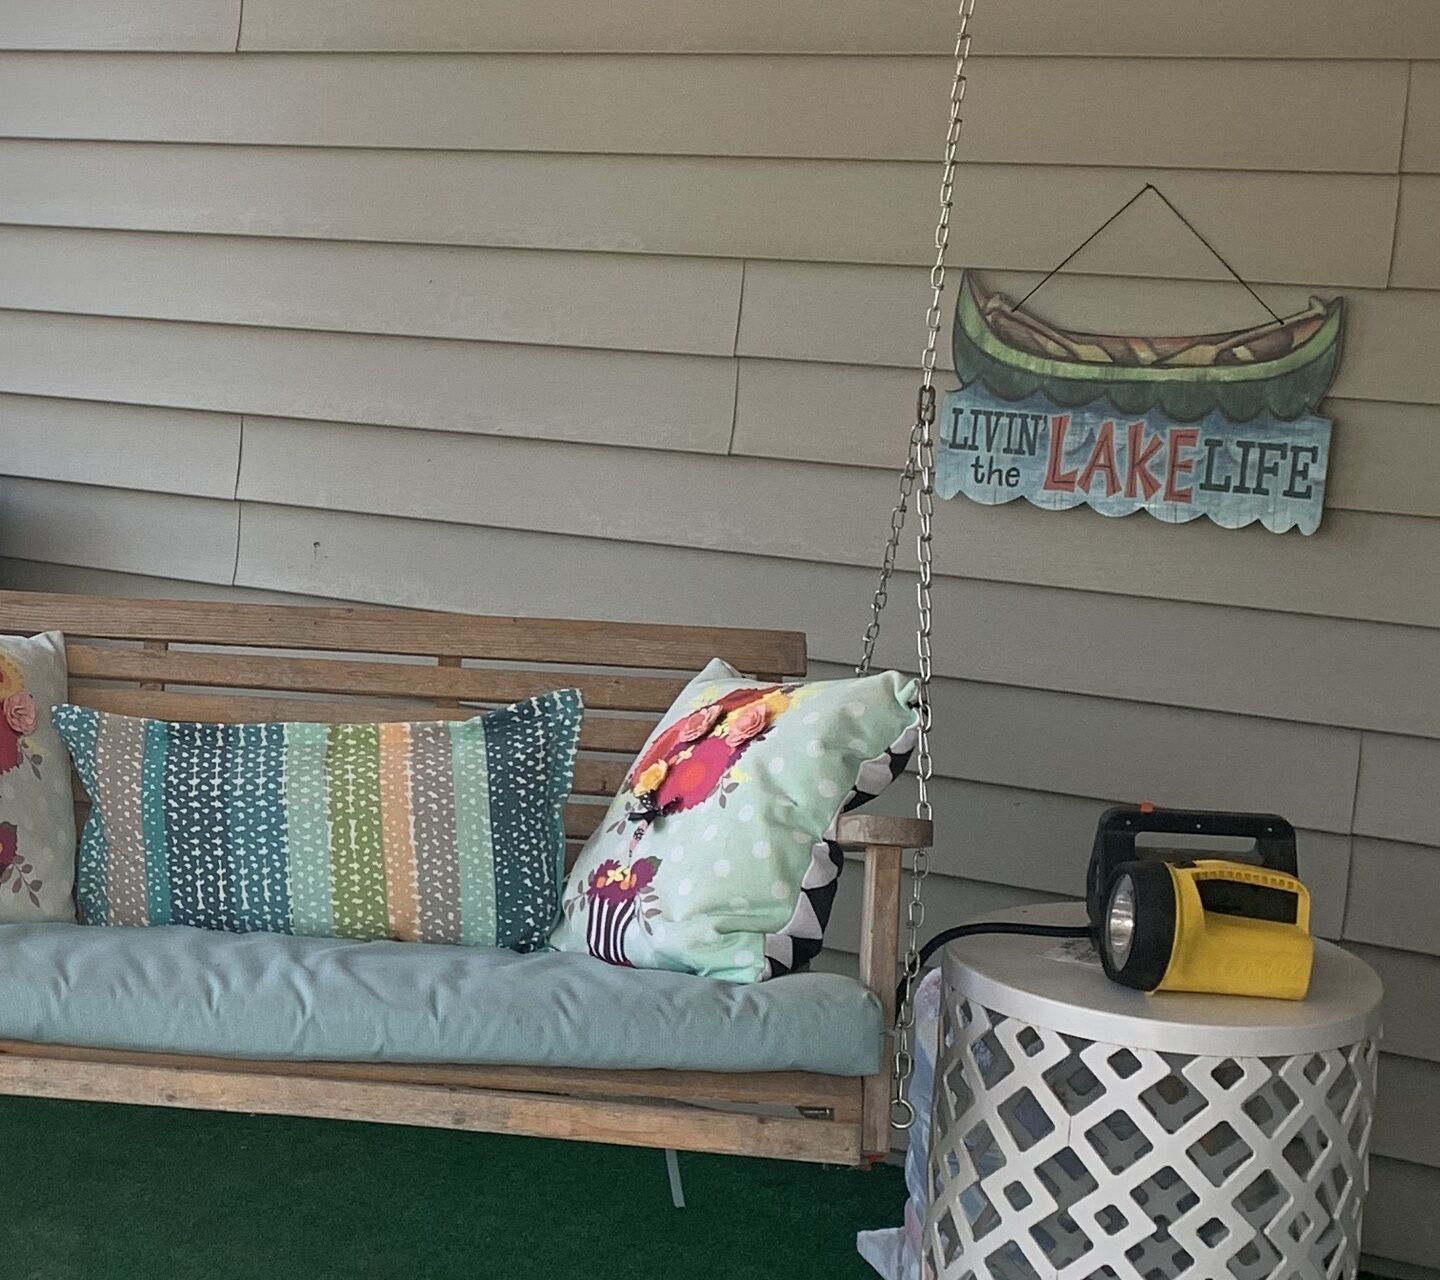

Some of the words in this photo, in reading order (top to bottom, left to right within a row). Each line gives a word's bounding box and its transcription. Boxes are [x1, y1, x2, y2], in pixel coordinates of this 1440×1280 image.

[947, 407, 1050, 458] LIVIN'
[971, 454, 1021, 488] the
[1042, 413, 1200, 504] LAKE
[1199, 437, 1320, 500] LIFE
